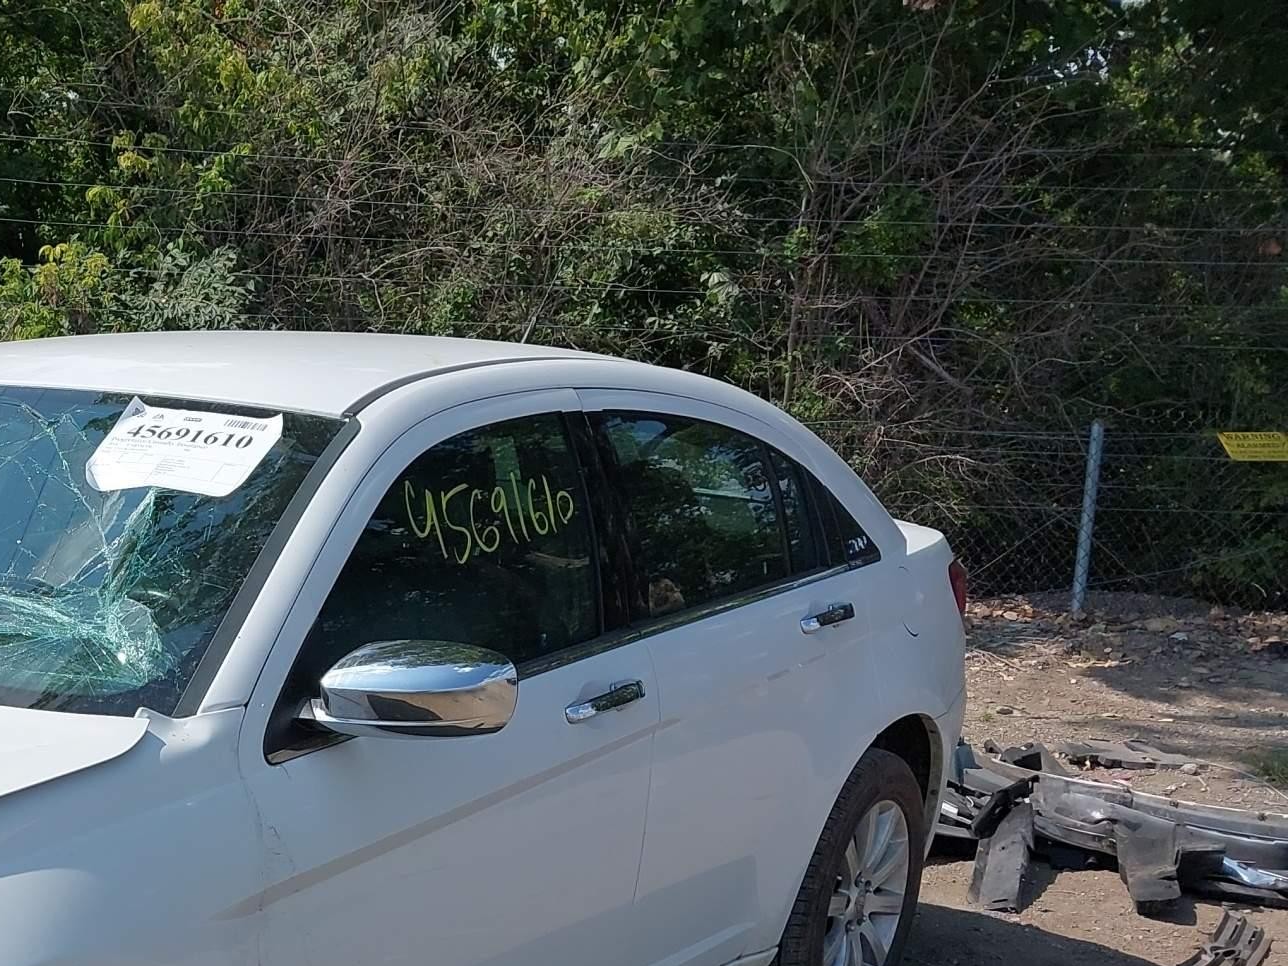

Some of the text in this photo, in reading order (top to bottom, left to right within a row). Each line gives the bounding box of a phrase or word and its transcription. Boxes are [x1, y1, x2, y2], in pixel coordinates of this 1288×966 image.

[126, 424, 254, 450] 45691610
[1223, 433, 1281, 441] WARNING
[404, 471, 574, 564] 45691610
